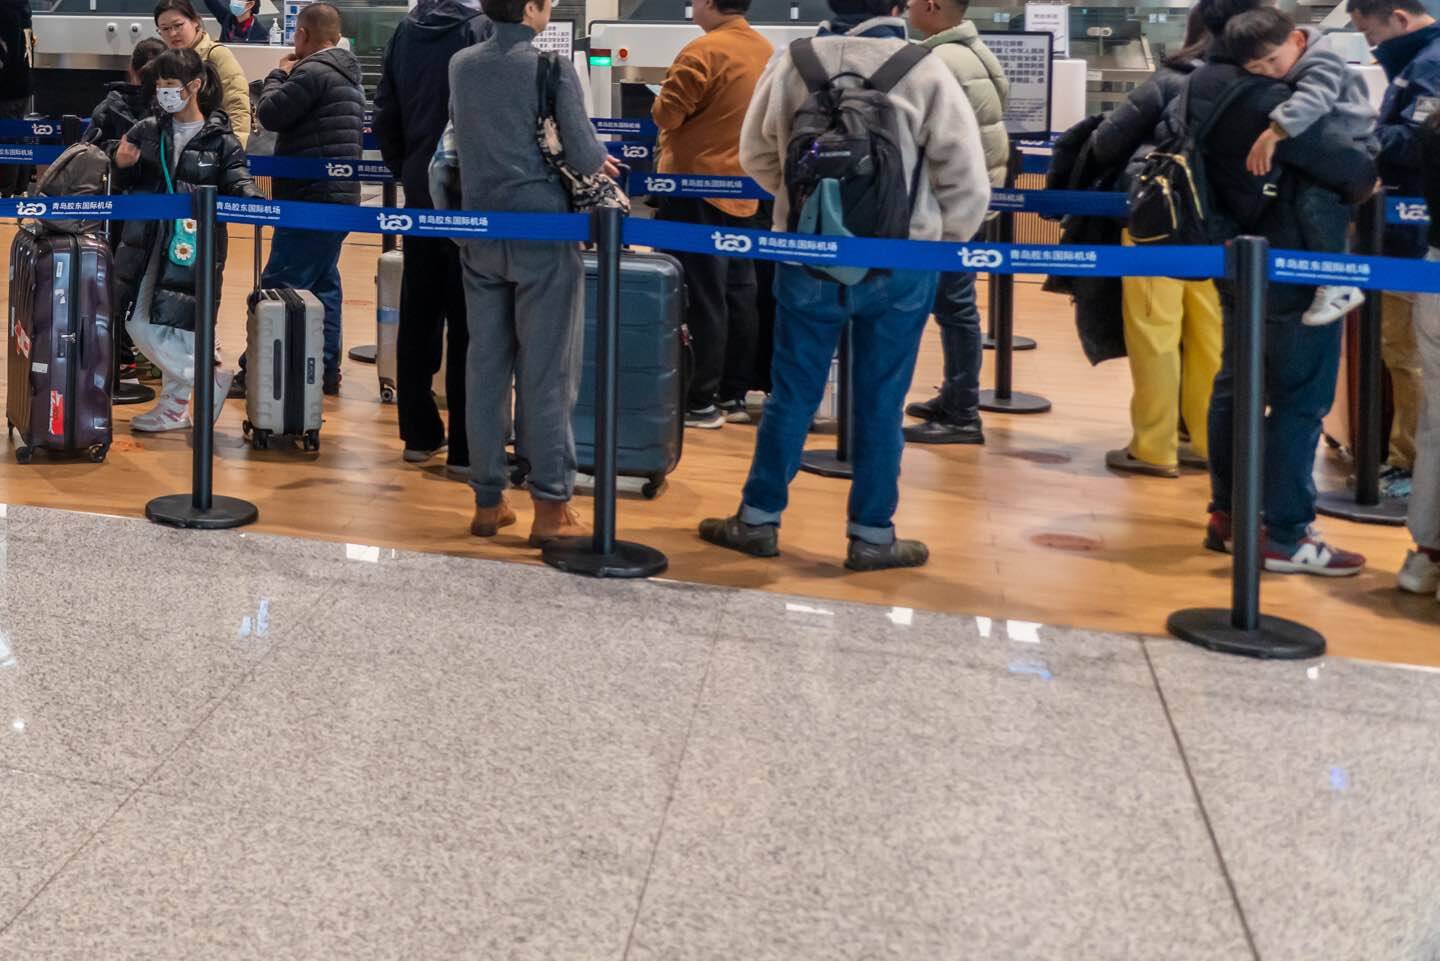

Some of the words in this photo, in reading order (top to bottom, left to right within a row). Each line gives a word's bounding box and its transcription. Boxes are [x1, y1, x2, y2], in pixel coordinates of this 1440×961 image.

[325, 162, 353, 177] tao
[645, 177, 676, 192] tao
[16, 201, 47, 216] tao
[376, 212, 413, 231] tao
[711, 231, 752, 253] tao
[956, 246, 1003, 268] tao
